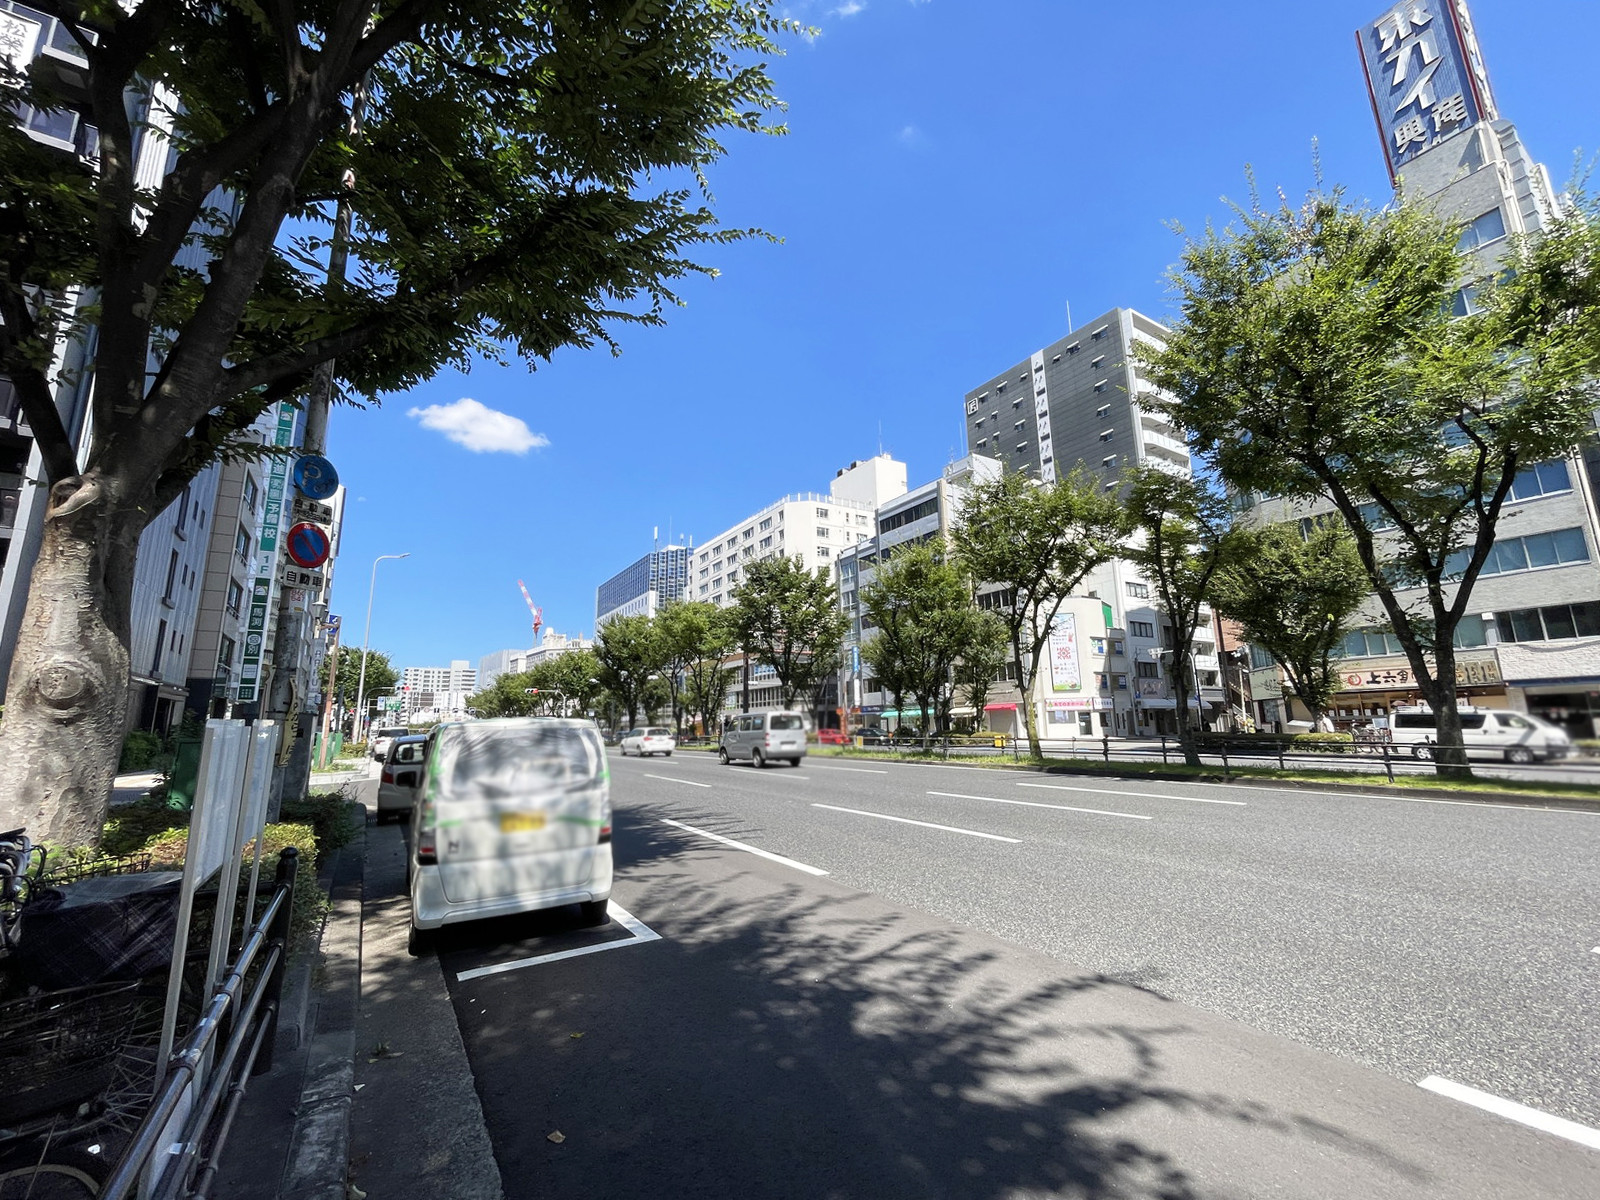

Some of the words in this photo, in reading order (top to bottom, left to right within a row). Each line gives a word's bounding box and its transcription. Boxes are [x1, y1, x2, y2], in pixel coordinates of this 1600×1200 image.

[1394, 93, 1468, 154] 興産
[294, 498, 333, 516] 自動車
[286, 570, 323, 587] 自動車
